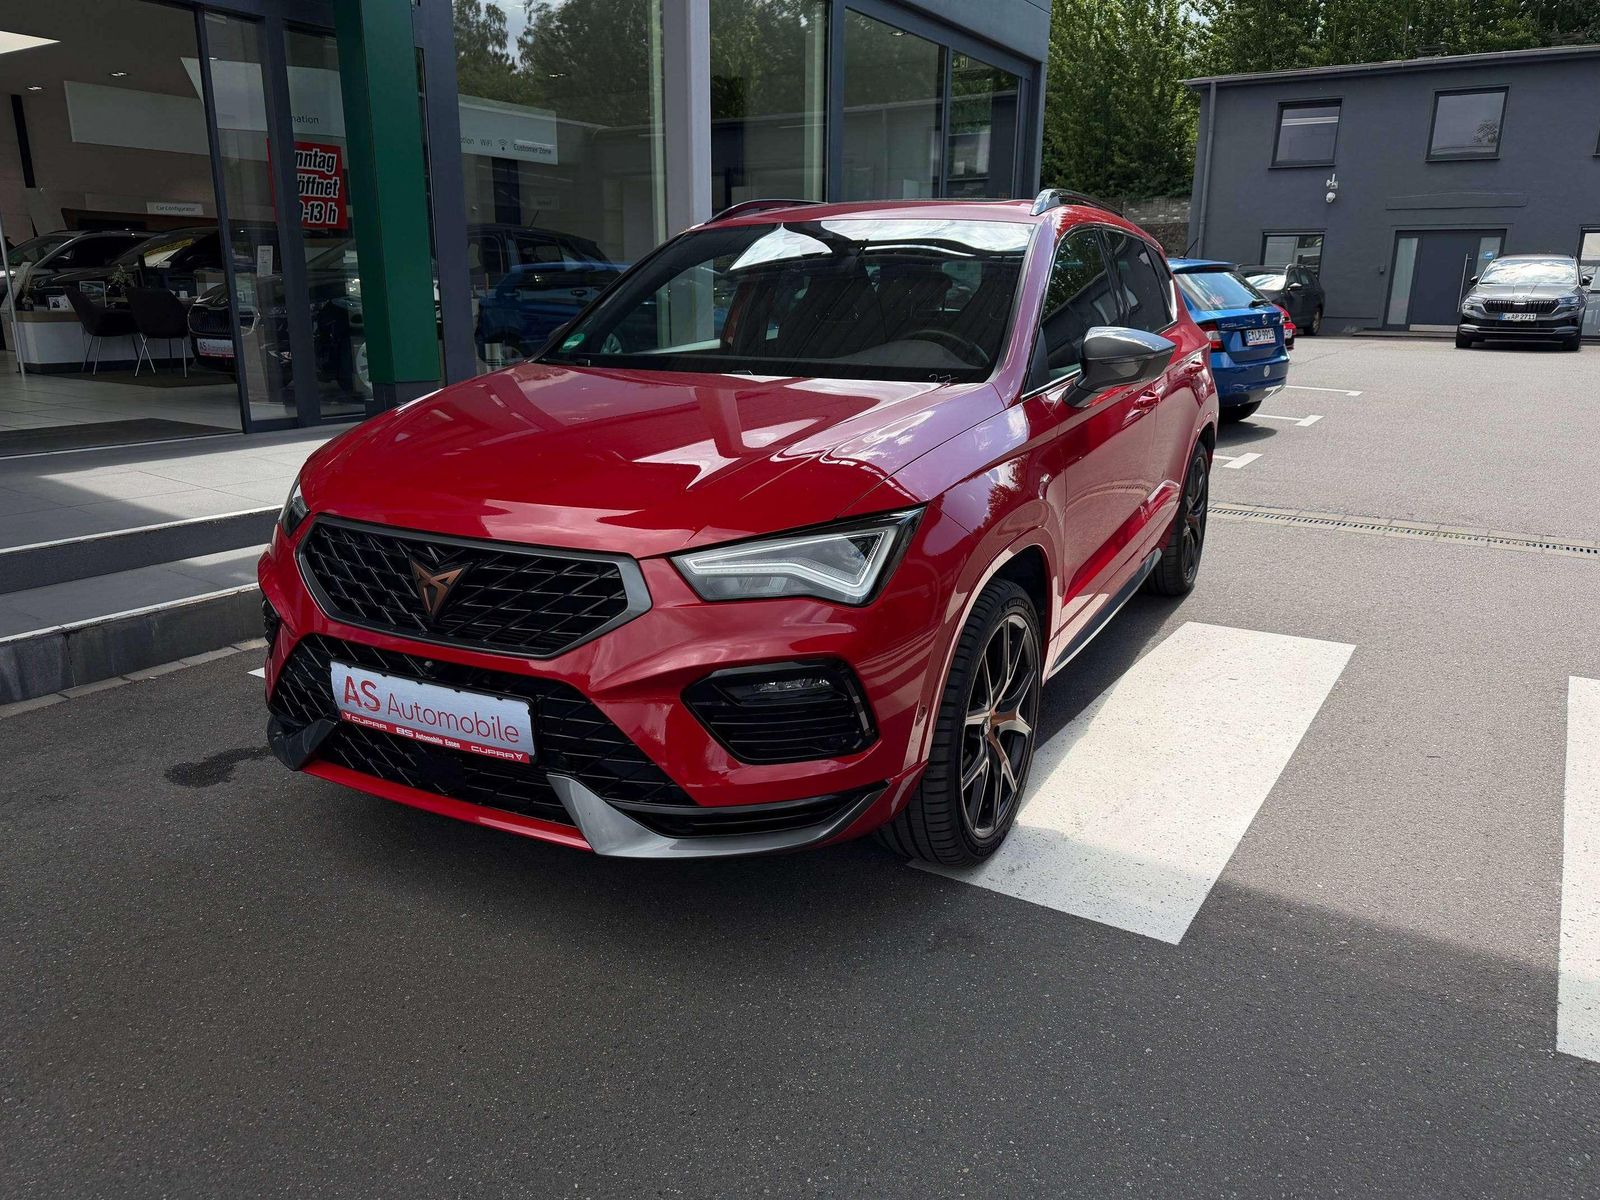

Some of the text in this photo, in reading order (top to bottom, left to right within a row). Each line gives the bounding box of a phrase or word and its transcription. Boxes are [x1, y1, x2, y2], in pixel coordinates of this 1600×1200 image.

[292, 115, 320, 125] ation
[295, 148, 336, 174] nntag
[513, 143, 538, 154] Customer
[538, 146, 552, 155] Zone
[298, 174, 340, 198] öffnet
[326, 202, 338, 224] h
[343, 675, 519, 744] AS Automobile
[352, 716, 388, 731] CUPRA
[470, 745, 515, 759] CUPRA
